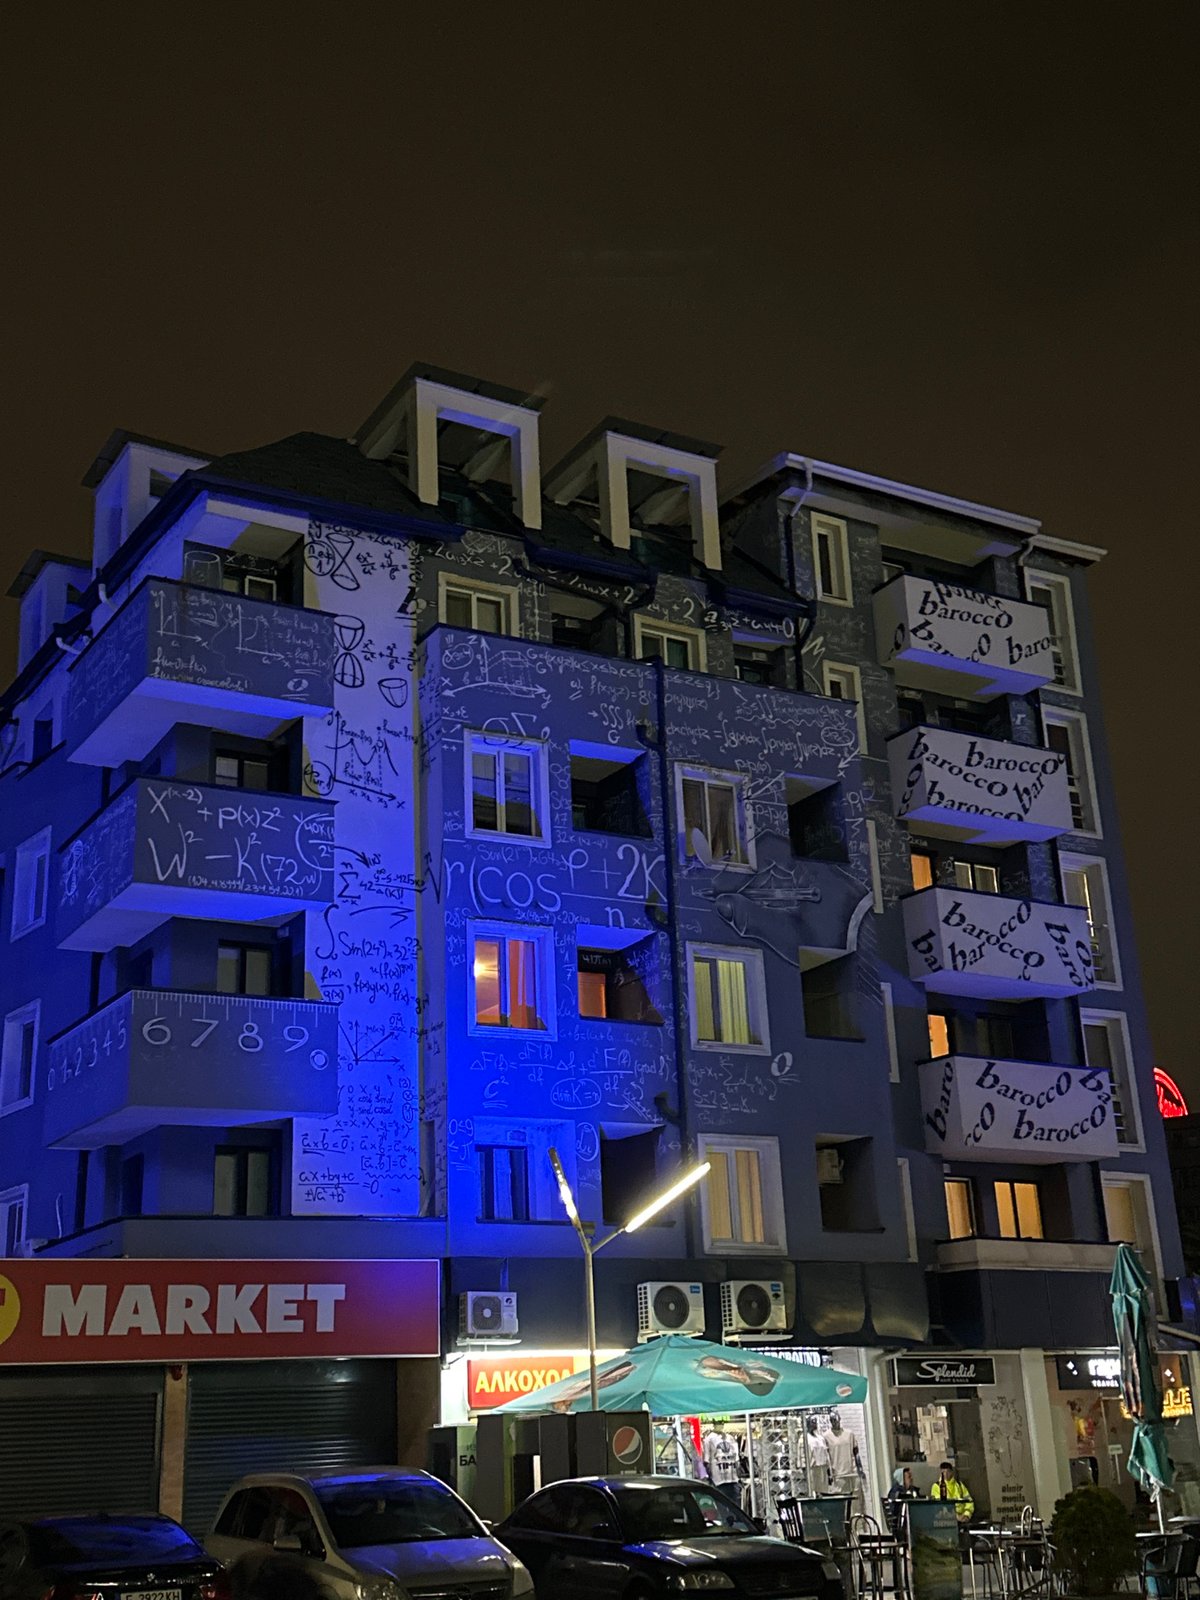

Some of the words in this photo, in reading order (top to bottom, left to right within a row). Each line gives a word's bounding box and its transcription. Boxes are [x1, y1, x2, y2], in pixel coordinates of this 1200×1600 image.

[142, 1017, 172, 1045] 6
[190, 1018, 219, 1047] 7
[238, 1022, 264, 1052] 8
[282, 1026, 309, 1053] 9
[42, 1283, 346, 1337] MARKET
[916, 1360, 976, 1382] Splendid
